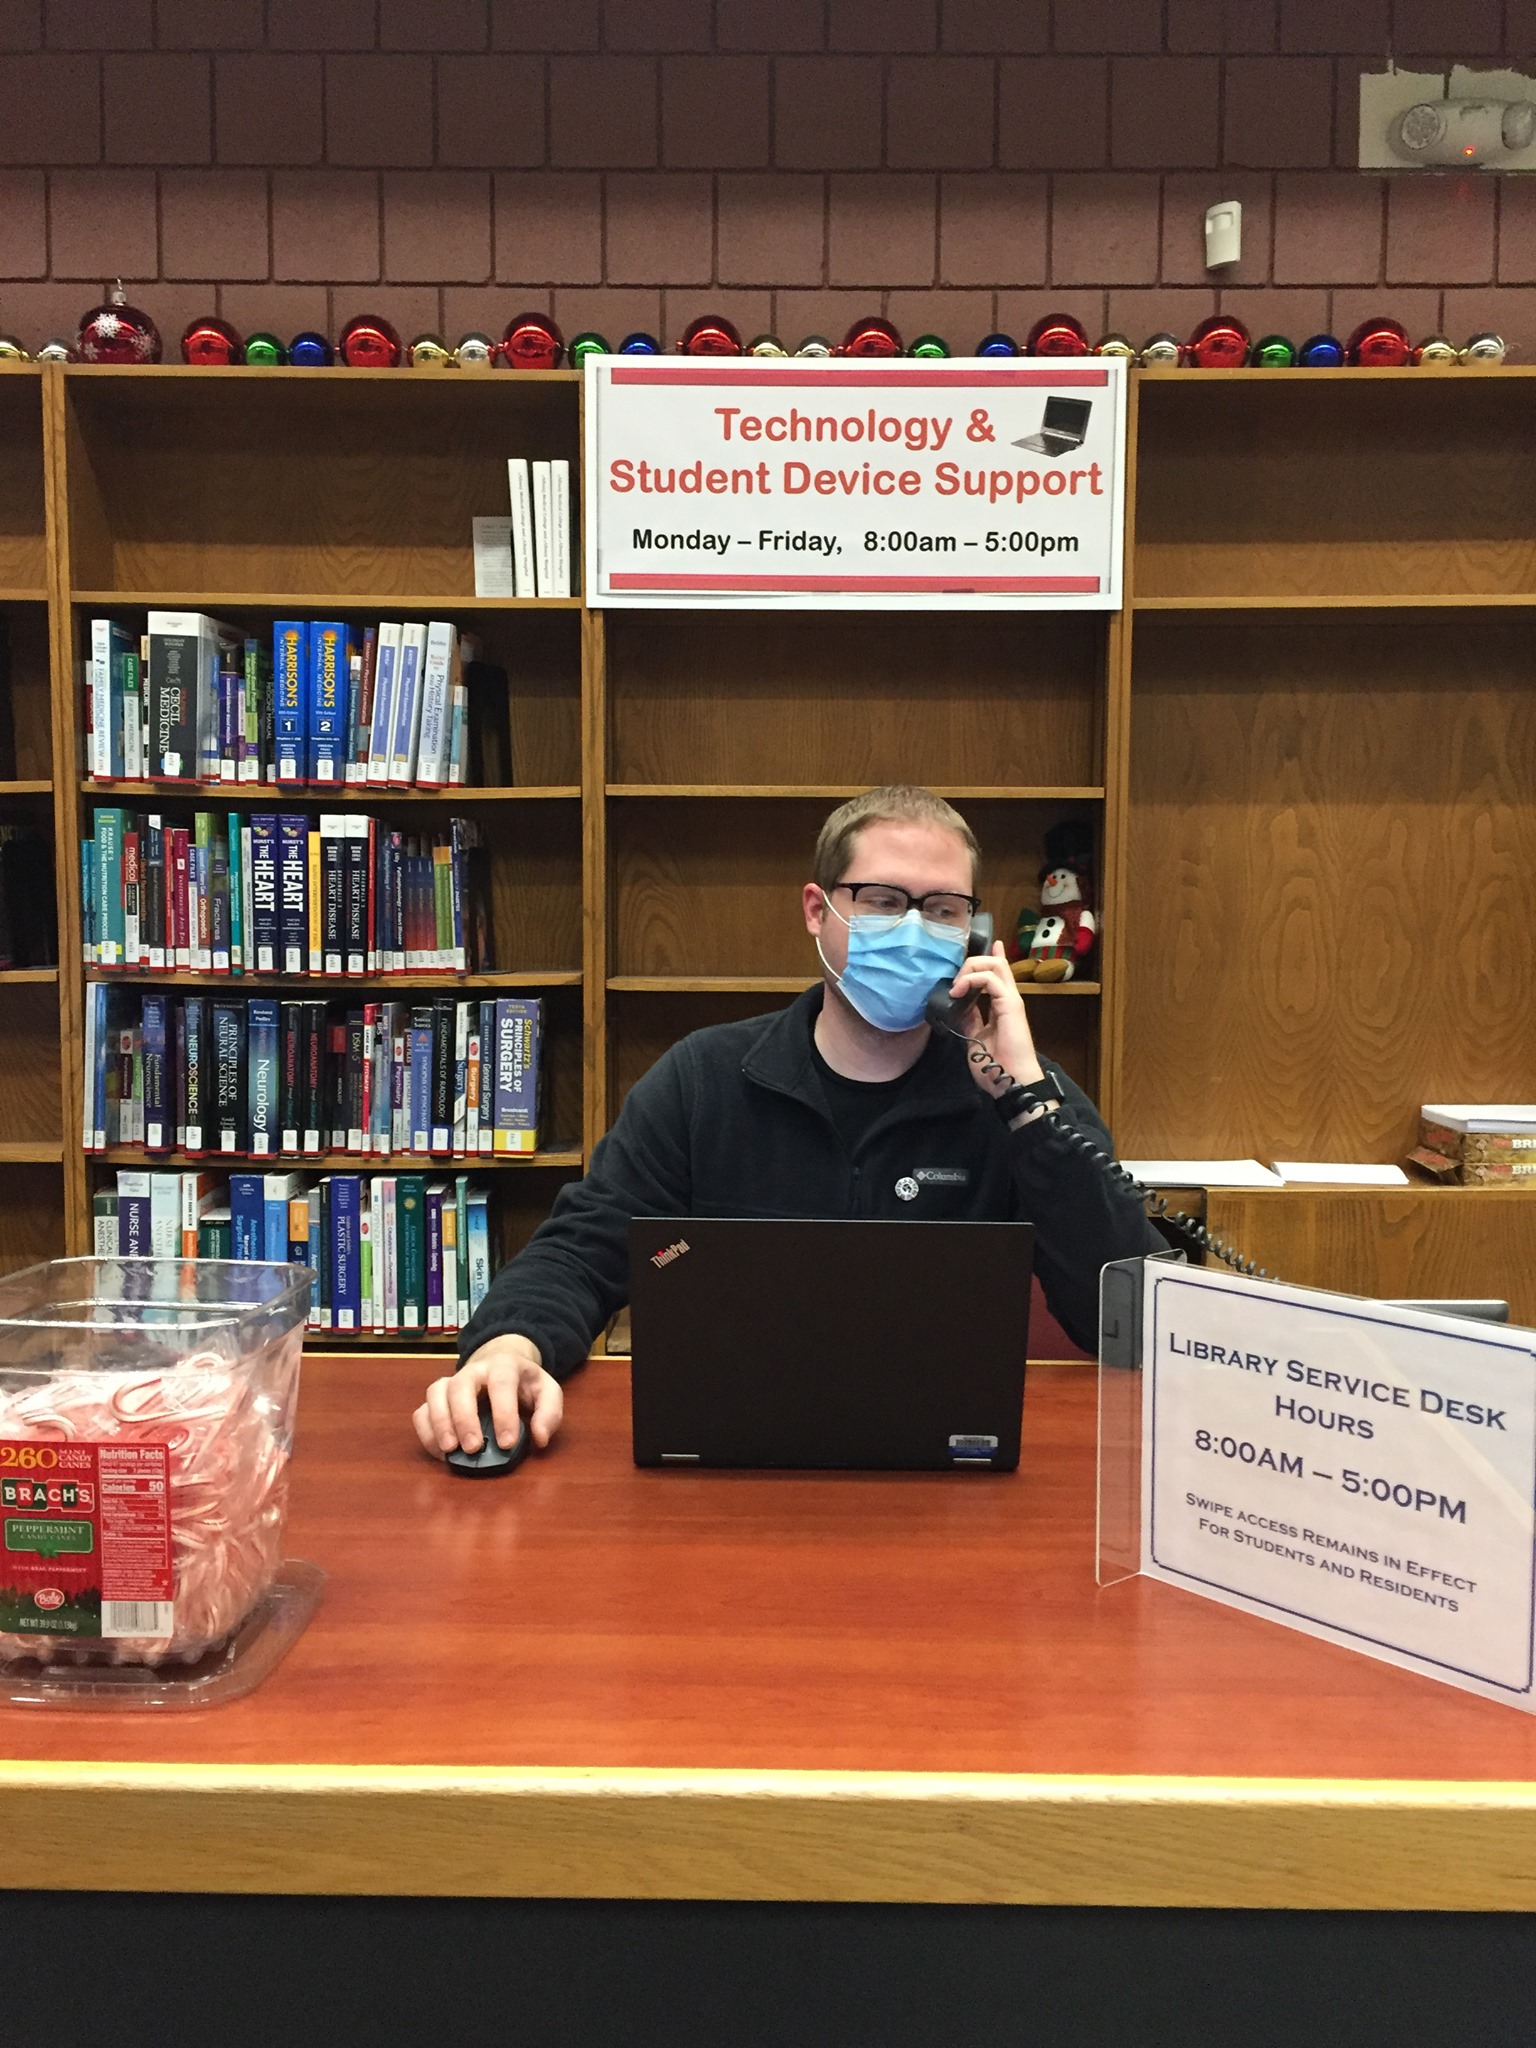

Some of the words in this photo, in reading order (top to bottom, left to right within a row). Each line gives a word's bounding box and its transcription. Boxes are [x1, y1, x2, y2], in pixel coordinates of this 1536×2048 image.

[714, 407, 952, 451] Technology
[965, 408, 996, 443] &
[609, 459, 770, 495] Student
[783, 462, 922, 496] Device
[933, 462, 1104, 505] Support
[632, 529, 731, 555] Monday
[758, 530, 843, 556] Friday,
[863, 531, 957, 553] 8:00am
[984, 531, 1079, 557] 5:00pm
[287, 637, 298, 707] HARRISON'S
[324, 637, 335, 708] HARRISON'S
[434, 674, 445, 706] Physical
[170, 687, 180, 726] CECIL
[426, 687, 434, 713] History
[160, 686, 170, 754] MEDICINE
[284, 721, 292, 731] 1
[320, 721, 331, 731] 2
[423, 715, 432, 738] Taking
[430, 707, 443, 755] Examination
[129, 847, 138, 882] medical
[259, 845, 269, 858] THE
[288, 845, 298, 859] THE
[254, 860, 275, 912] HEART
[283, 860, 304, 912] HEART
[328, 870, 336, 901] HEART
[351, 870, 360, 901] HEART
[200, 898, 208, 939] Orthopaedics
[214, 898, 222, 941] Fractures
[328, 903, 336, 940] DISEASE
[351, 903, 360, 940] DISEASE
[219, 1016, 228, 1060] NEURAL
[228, 1023, 238, 1083] PRINCIPLES
[440, 1017, 448, 1069] FUNDAMENTALS
[499, 1018, 513, 1093] SURGERY
[514, 1018, 523, 1077] PRINCIPLES
[523, 1018, 533, 1070] Schwartz's
[134, 1056, 142, 1098] Neurology
[188, 1034, 199, 1114] NEUROSCIENCE
[287, 1031, 296, 1088] NEUROANATOMY
[310, 1032, 319, 1089] NEUROANATOMY
[420, 1055, 428, 1085] SYNOPSIS
[440, 1070, 447, 1079] OF
[455, 1061, 466, 1092] Surgery
[483, 1063, 492, 1091] General
[154, 1054, 162, 1107] Fundamental
[218, 1062, 229, 1107] SCIENCE
[228, 1085, 238, 1100] OF
[253, 1059, 270, 1131] Neurology
[394, 1065, 402, 1104] Psychiatry
[421, 1086, 428, 1094] OF
[438, 1080, 447, 1118] RADIOLOGY
[469, 1066, 478, 1101] Surgery
[513, 1079, 522, 1093] OF
[420, 1094, 428, 1131] PSYCHIATRY
[481, 1091, 491, 1120] Surgery
[129, 1203, 139, 1236] NURSE
[235, 1214, 244, 1243] Surgical
[337, 1215, 347, 1252] PLASTIC
[475, 1258, 484, 1280] Skin
[650, 1238, 691, 1269] ThinkPad
[337, 1254, 347, 1295] SURGERY
[1169, 1332, 1278, 1376] LIBRARY
[1286, 1359, 1411, 1408] SERVICE
[1420, 1389, 1507, 1432] DESK
[1275, 1395, 1374, 1440] HOURS
[0, 1447, 58, 1469] 260
[58, 1454, 93, 1462] CANDY
[58, 1461, 92, 1469] CANES
[100, 1449, 138, 1460] Nutrition
[140, 1449, 164, 1460] Facts
[4, 1486, 91, 1504] BRACH'S
[101, 1483, 136, 1492] Calories
[148, 1481, 164, 1492] 50
[1194, 1429, 1304, 1478] 8:00AM
[1341, 1469, 1467, 1524] 5:00PM
[12, 1524, 85, 1535] PEPPERMINT
[1185, 1493, 1234, 1519] SWIPE
[1236, 1510, 1299, 1539] ACCESS
[1302, 1529, 1379, 1564] REMAINS
[1383, 1555, 1400, 1570] IN
[1406, 1560, 1478, 1593] EFFECT
[1198, 1518, 1231, 1539] FOR
[1233, 1529, 1316, 1567] STUDENTS
[1319, 1559, 1355, 1580] AND
[1359, 1570, 1460, 1613] RESIDENTS
[19, 1618, 30, 1627] NET
[30, 1619, 39, 1628] WT
